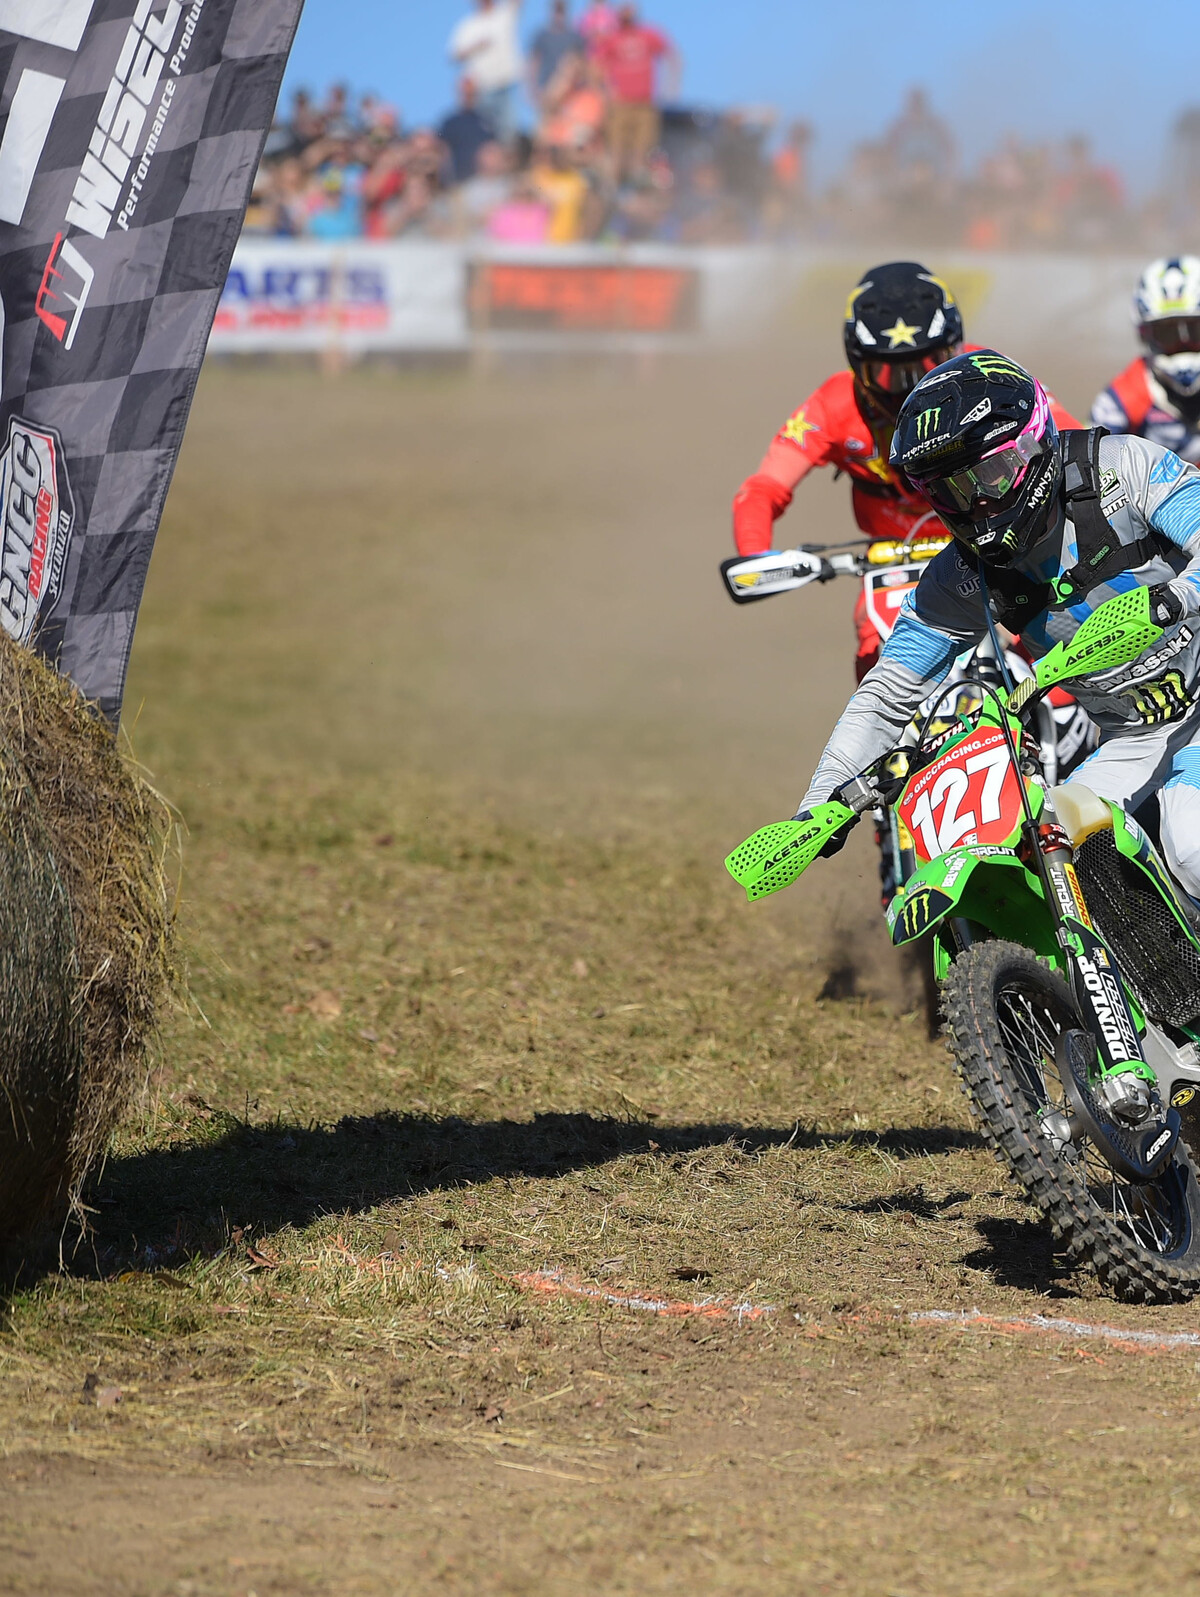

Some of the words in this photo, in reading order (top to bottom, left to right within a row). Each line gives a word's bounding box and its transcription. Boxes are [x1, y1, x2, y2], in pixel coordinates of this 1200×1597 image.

[65, 0, 183, 239] WISEC
[116, 80, 176, 231] Performance
[220, 269, 384, 299] ARTS
[902, 432, 951, 460] MONSTER
[1028, 455, 1056, 509] MONST
[0, 432, 41, 640] GNCC
[28, 486, 53, 599] RACING
[49, 509, 71, 599] SPECIALIZED
[1065, 629, 1126, 668] ACERBIS
[1079, 624, 1195, 692] Kawasaki
[910, 743, 1012, 859] 127
[763, 826, 821, 872] ACERBIS
[1049, 866, 1075, 918] IRCUIT
[1068, 870, 1092, 928] SHOWA
[1077, 955, 1129, 1062] DUNLOP
[1100, 971, 1143, 1061] WISECO
